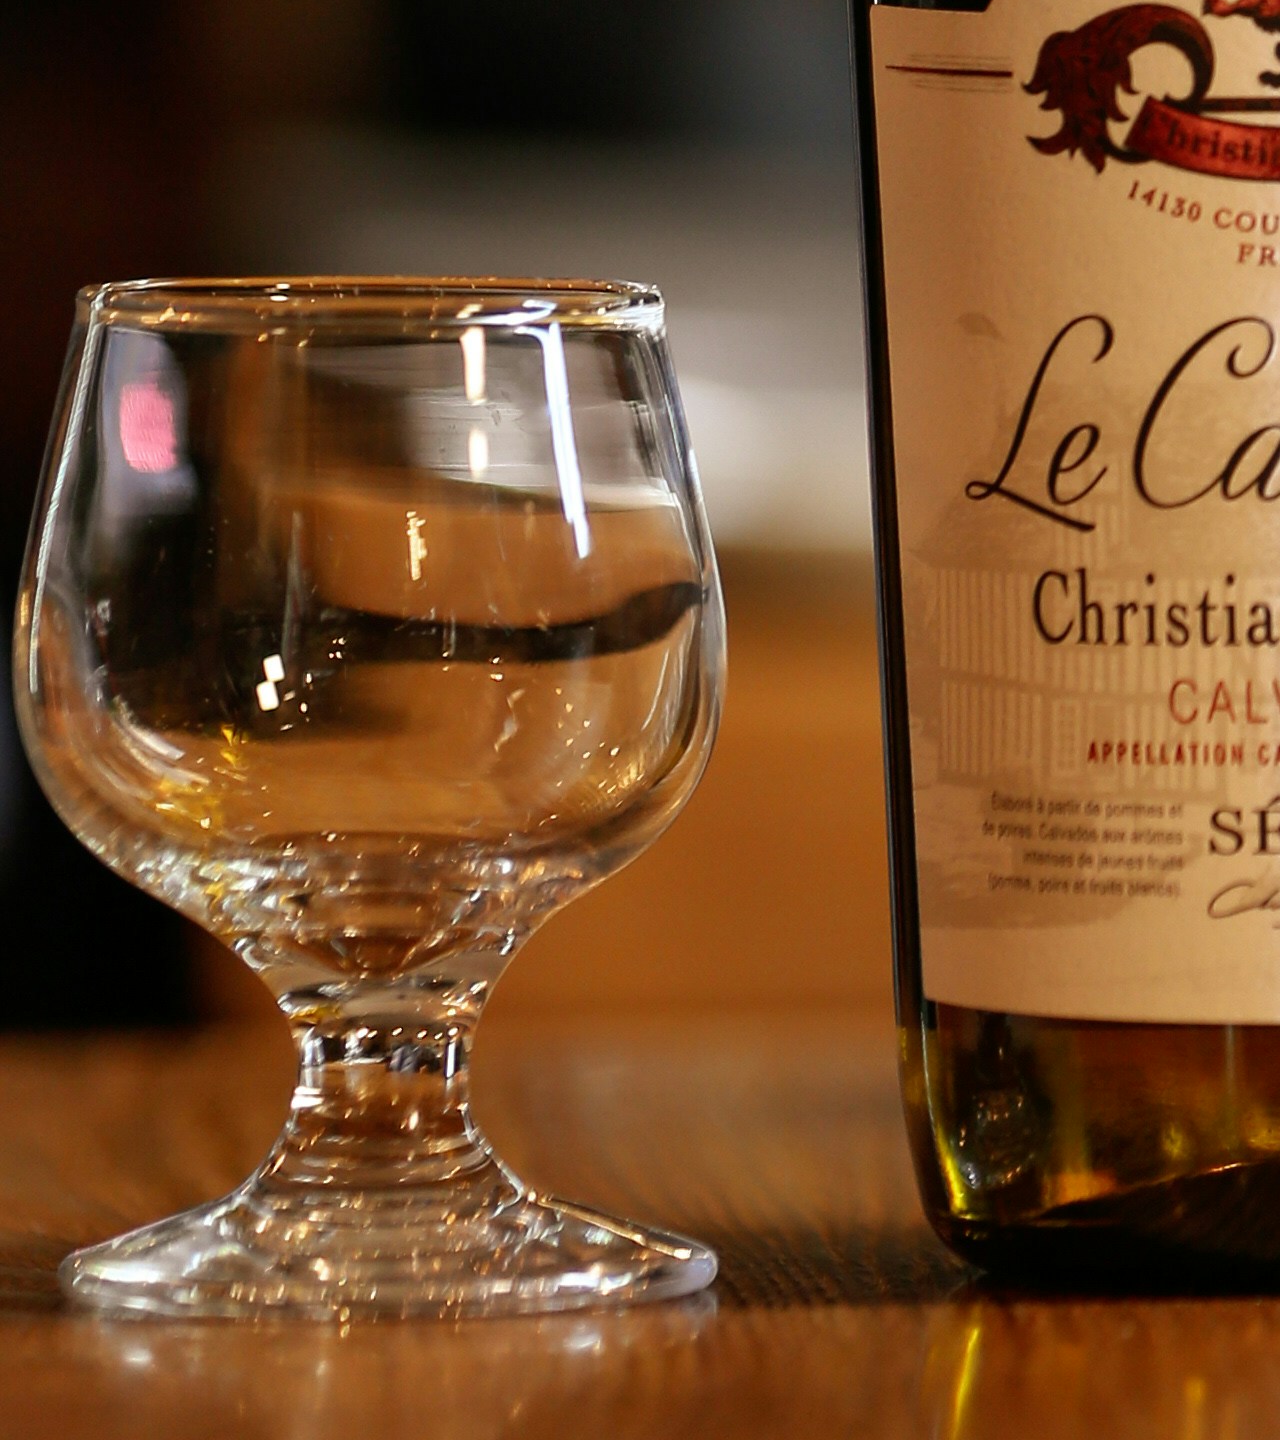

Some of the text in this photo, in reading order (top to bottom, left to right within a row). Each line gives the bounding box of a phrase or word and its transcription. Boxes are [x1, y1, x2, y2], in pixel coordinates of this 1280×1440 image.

[1127, 180, 1201, 222] 14130
[964, 313, 1115, 532] Le
[1087, 739, 1245, 767] APPELLATION
